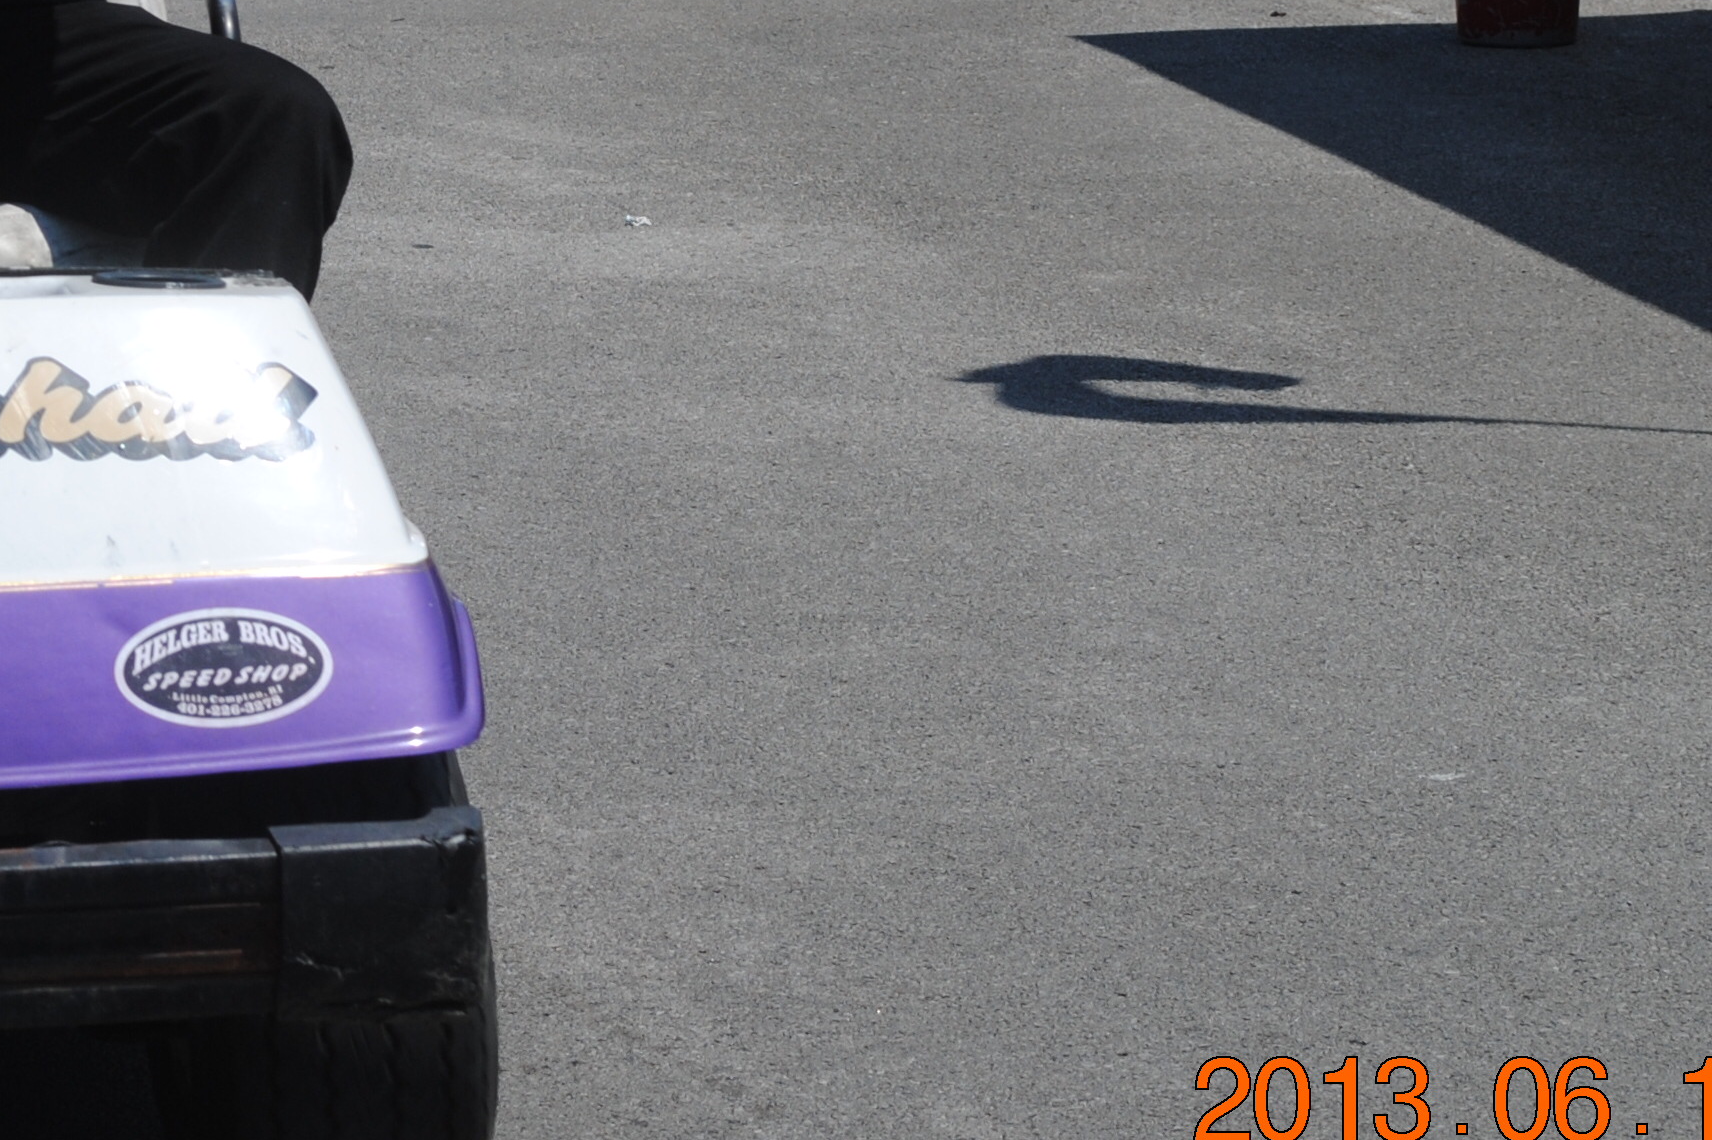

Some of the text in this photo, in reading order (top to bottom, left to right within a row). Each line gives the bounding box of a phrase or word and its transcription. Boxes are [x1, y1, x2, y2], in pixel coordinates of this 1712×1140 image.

[132, 620, 316, 677] HELGER BROS.
[142, 663, 308, 692] SPEED SHOP
[172, 691, 208, 704] Little
[209, 689, 268, 705] Compton,
